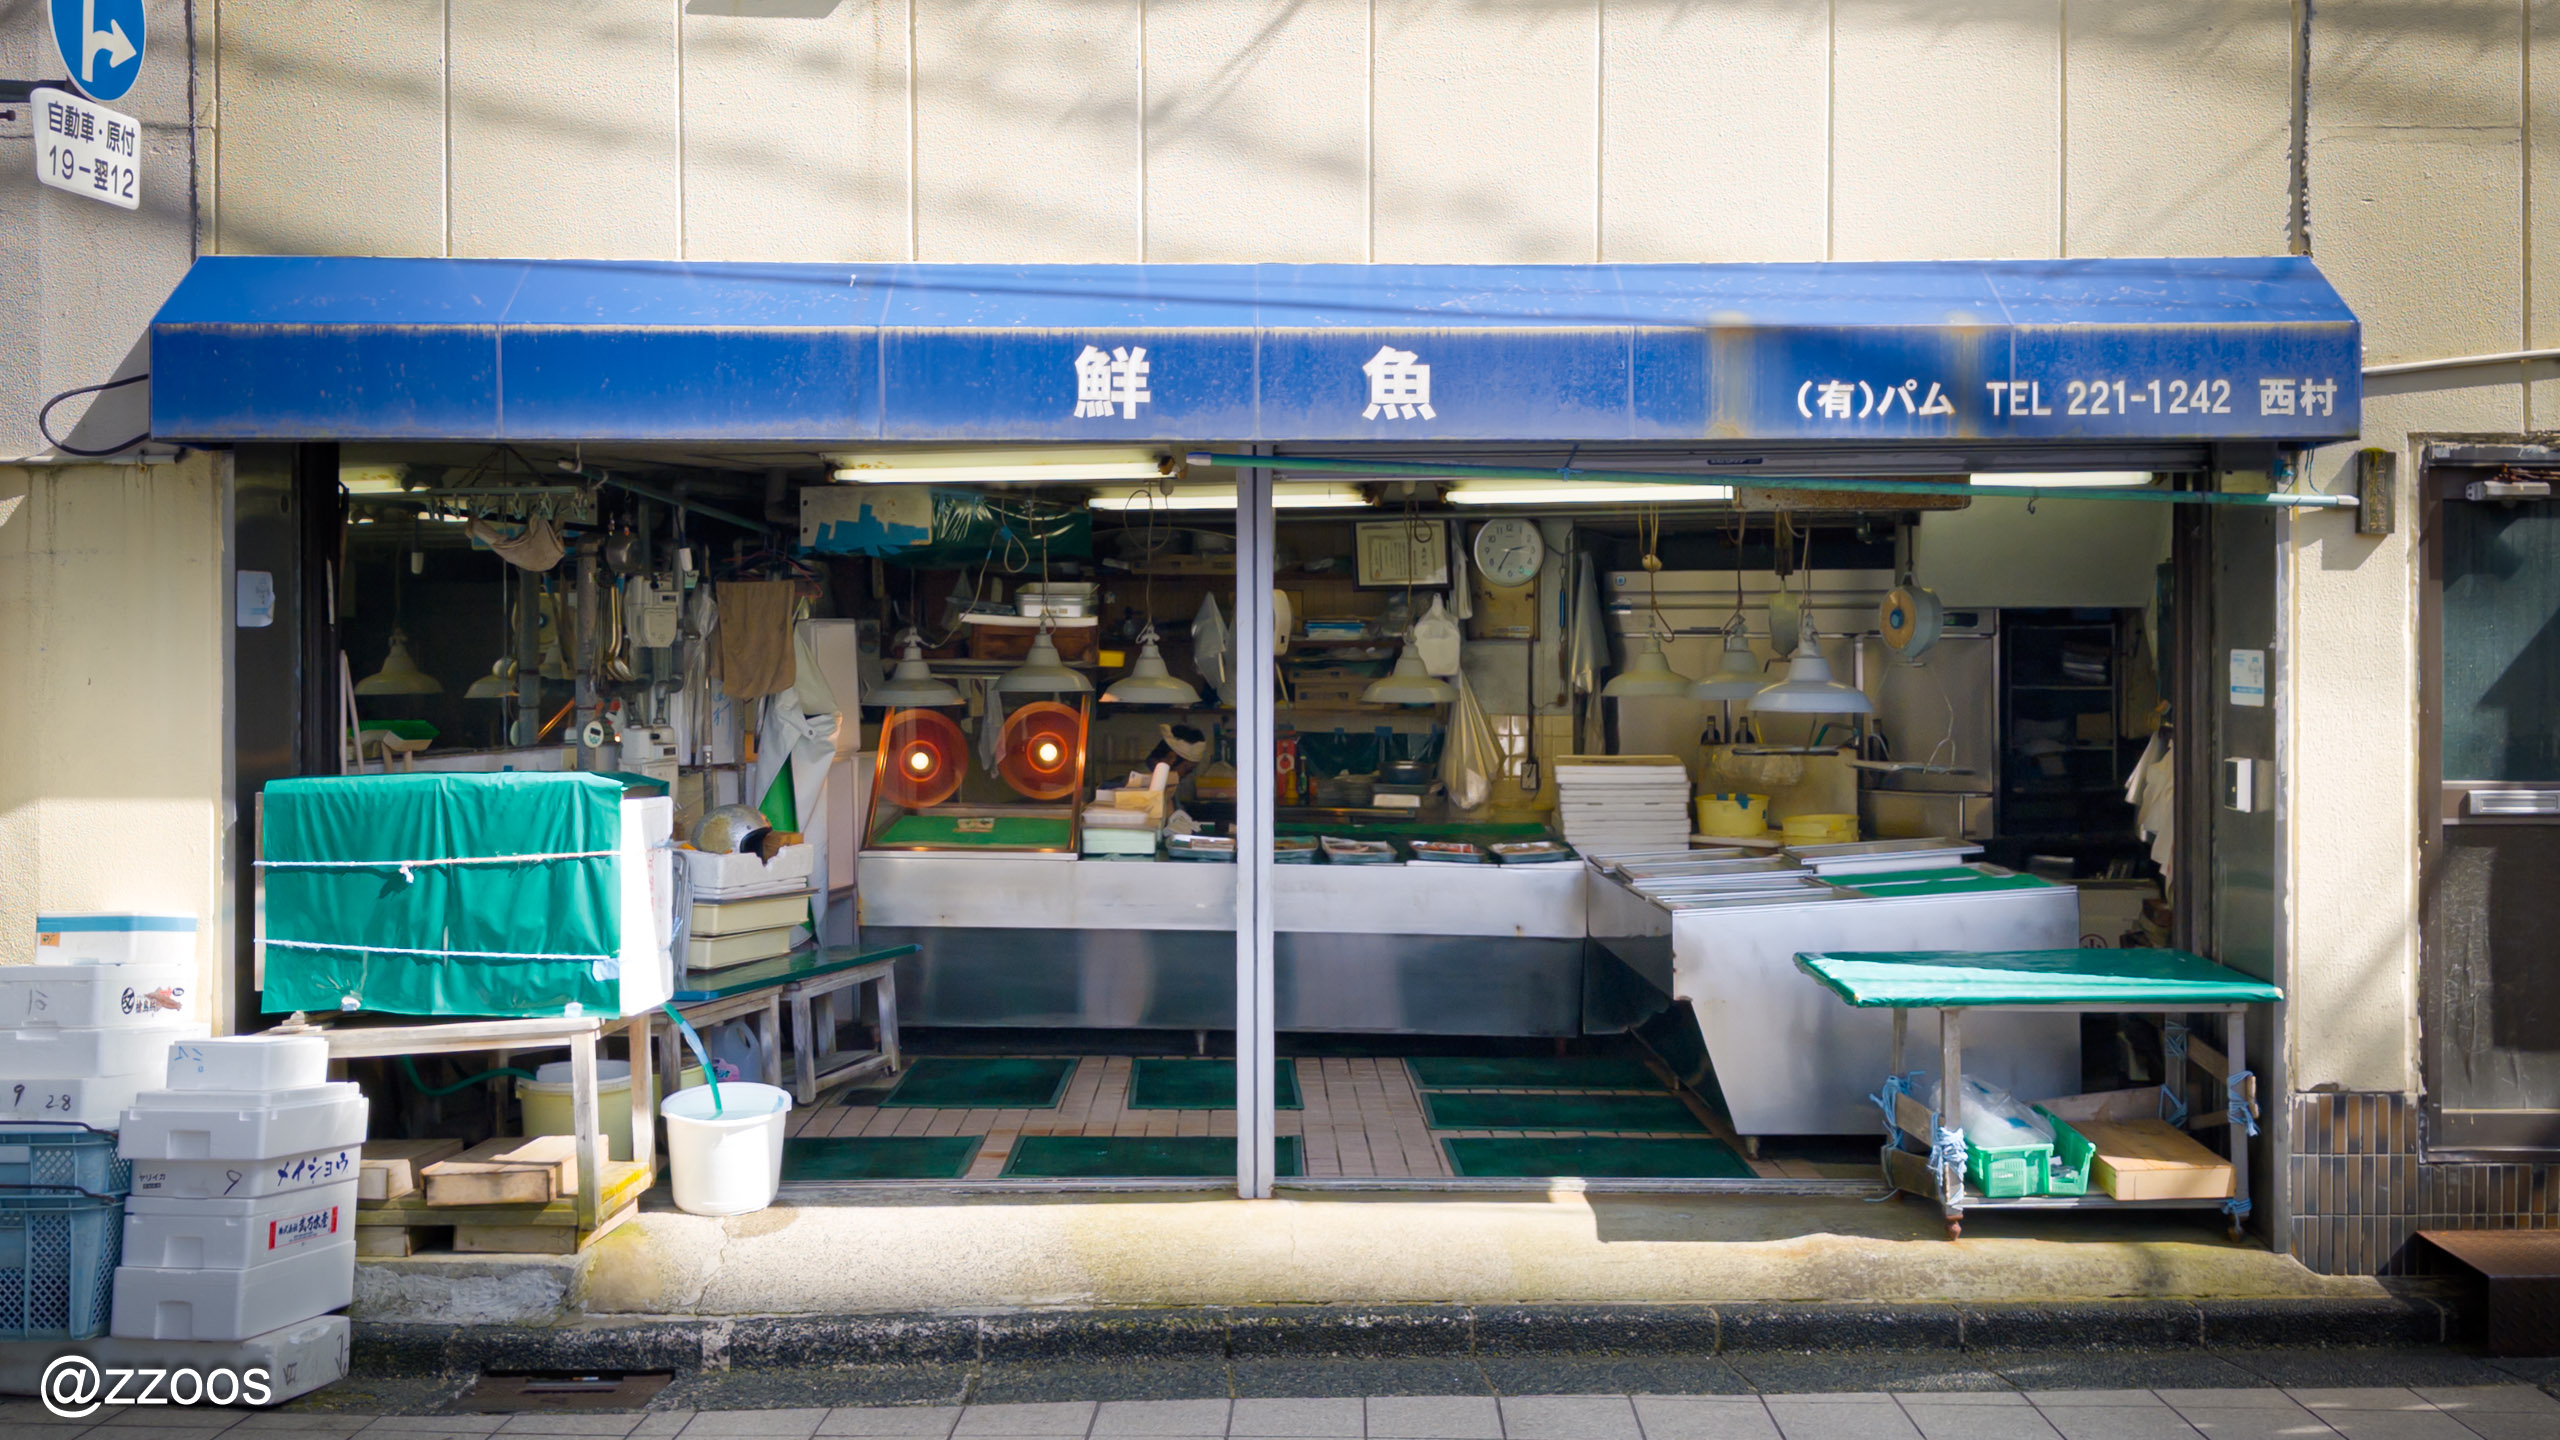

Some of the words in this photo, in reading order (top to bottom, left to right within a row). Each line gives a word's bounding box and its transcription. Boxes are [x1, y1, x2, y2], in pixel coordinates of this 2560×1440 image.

[48, 101, 135, 157] 自動車・原付
[1986, 381, 2032, 416] TEL
[2067, 379, 2231, 415] 221-1242
[2259, 378, 2338, 417] 西村
[277, 1151, 349, 1187] メイショウ
